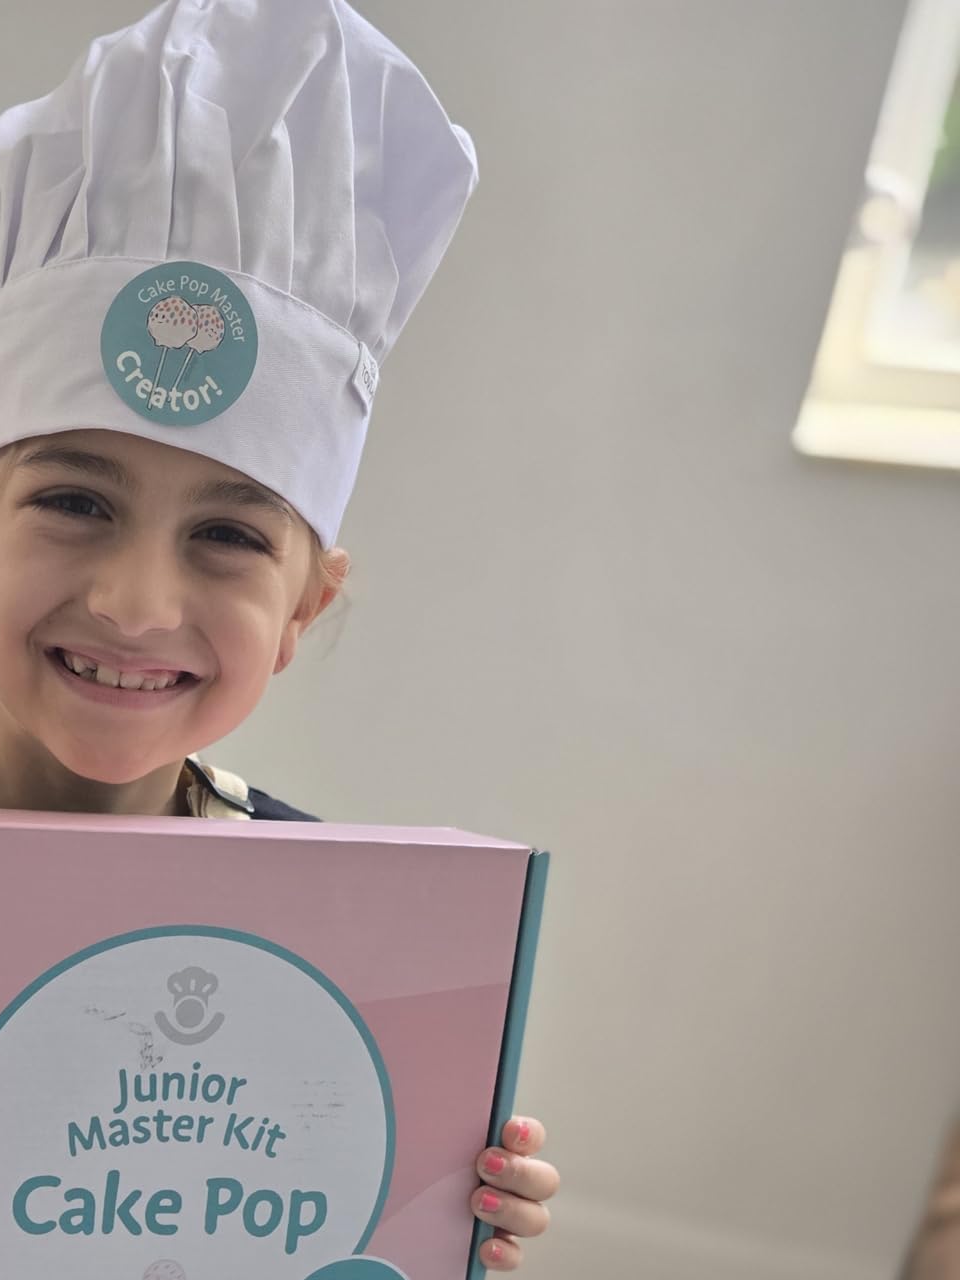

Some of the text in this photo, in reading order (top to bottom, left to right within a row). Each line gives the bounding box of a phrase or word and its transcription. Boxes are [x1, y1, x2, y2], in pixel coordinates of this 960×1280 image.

[138, 275, 246, 343] Cake Pop Master
[116, 350, 223, 412] Creator!
[113, 1062, 247, 1113] Junior
[68, 1110, 286, 1158] Master Kit
[12, 1170, 328, 1254] Cake Pop
